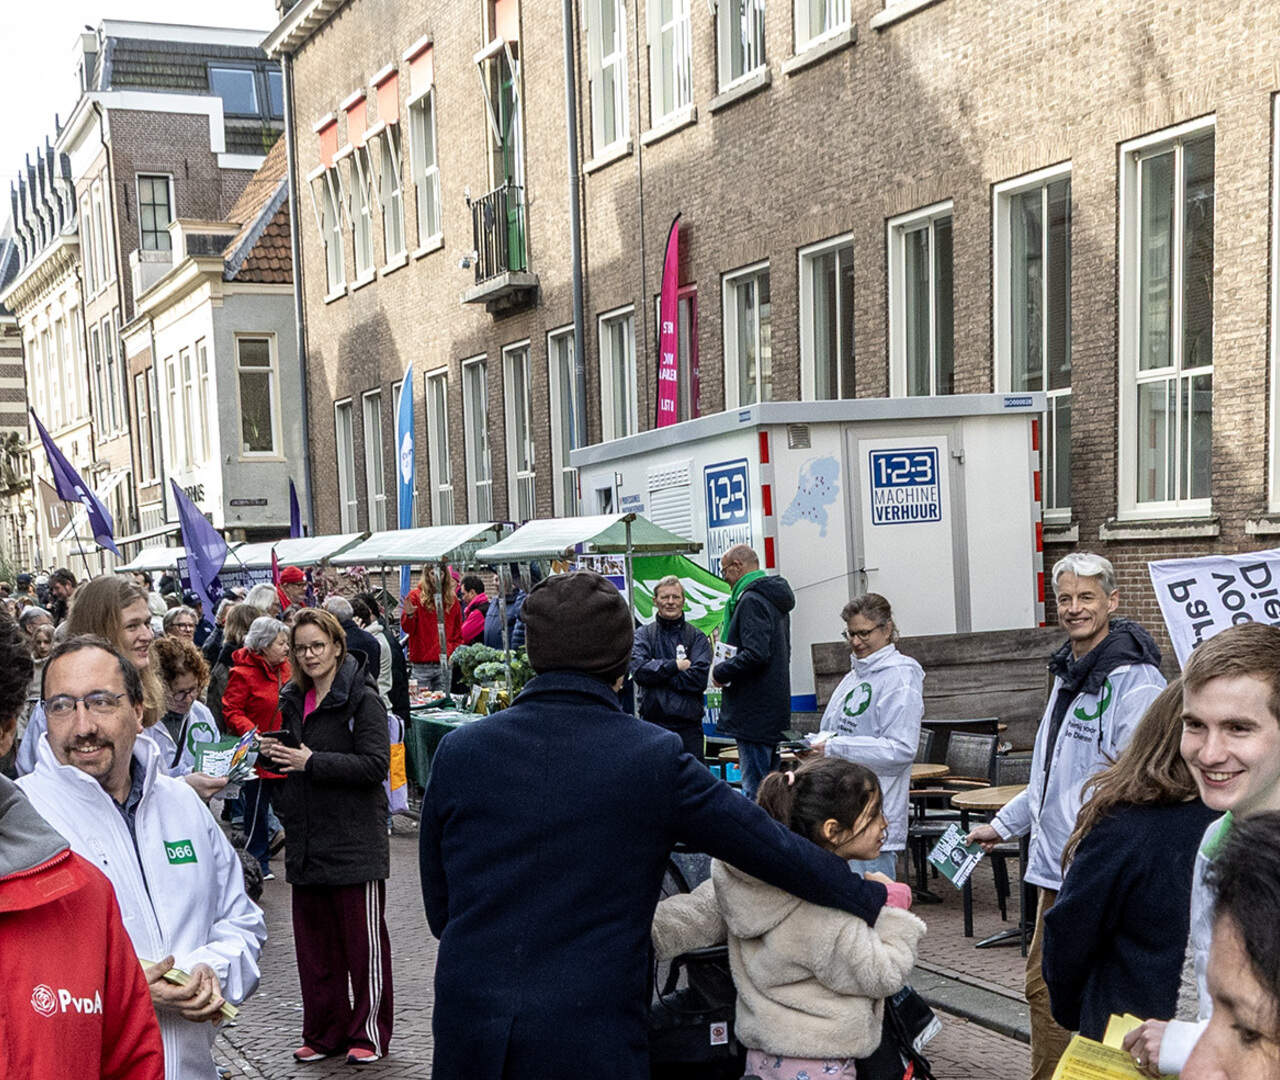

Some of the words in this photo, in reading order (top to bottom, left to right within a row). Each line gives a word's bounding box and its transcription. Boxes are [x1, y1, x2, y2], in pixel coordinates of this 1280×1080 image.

[874, 486, 937, 505] MACHINE
[875, 503, 938, 521] VERHUUR
[166, 844, 193, 860] D66
